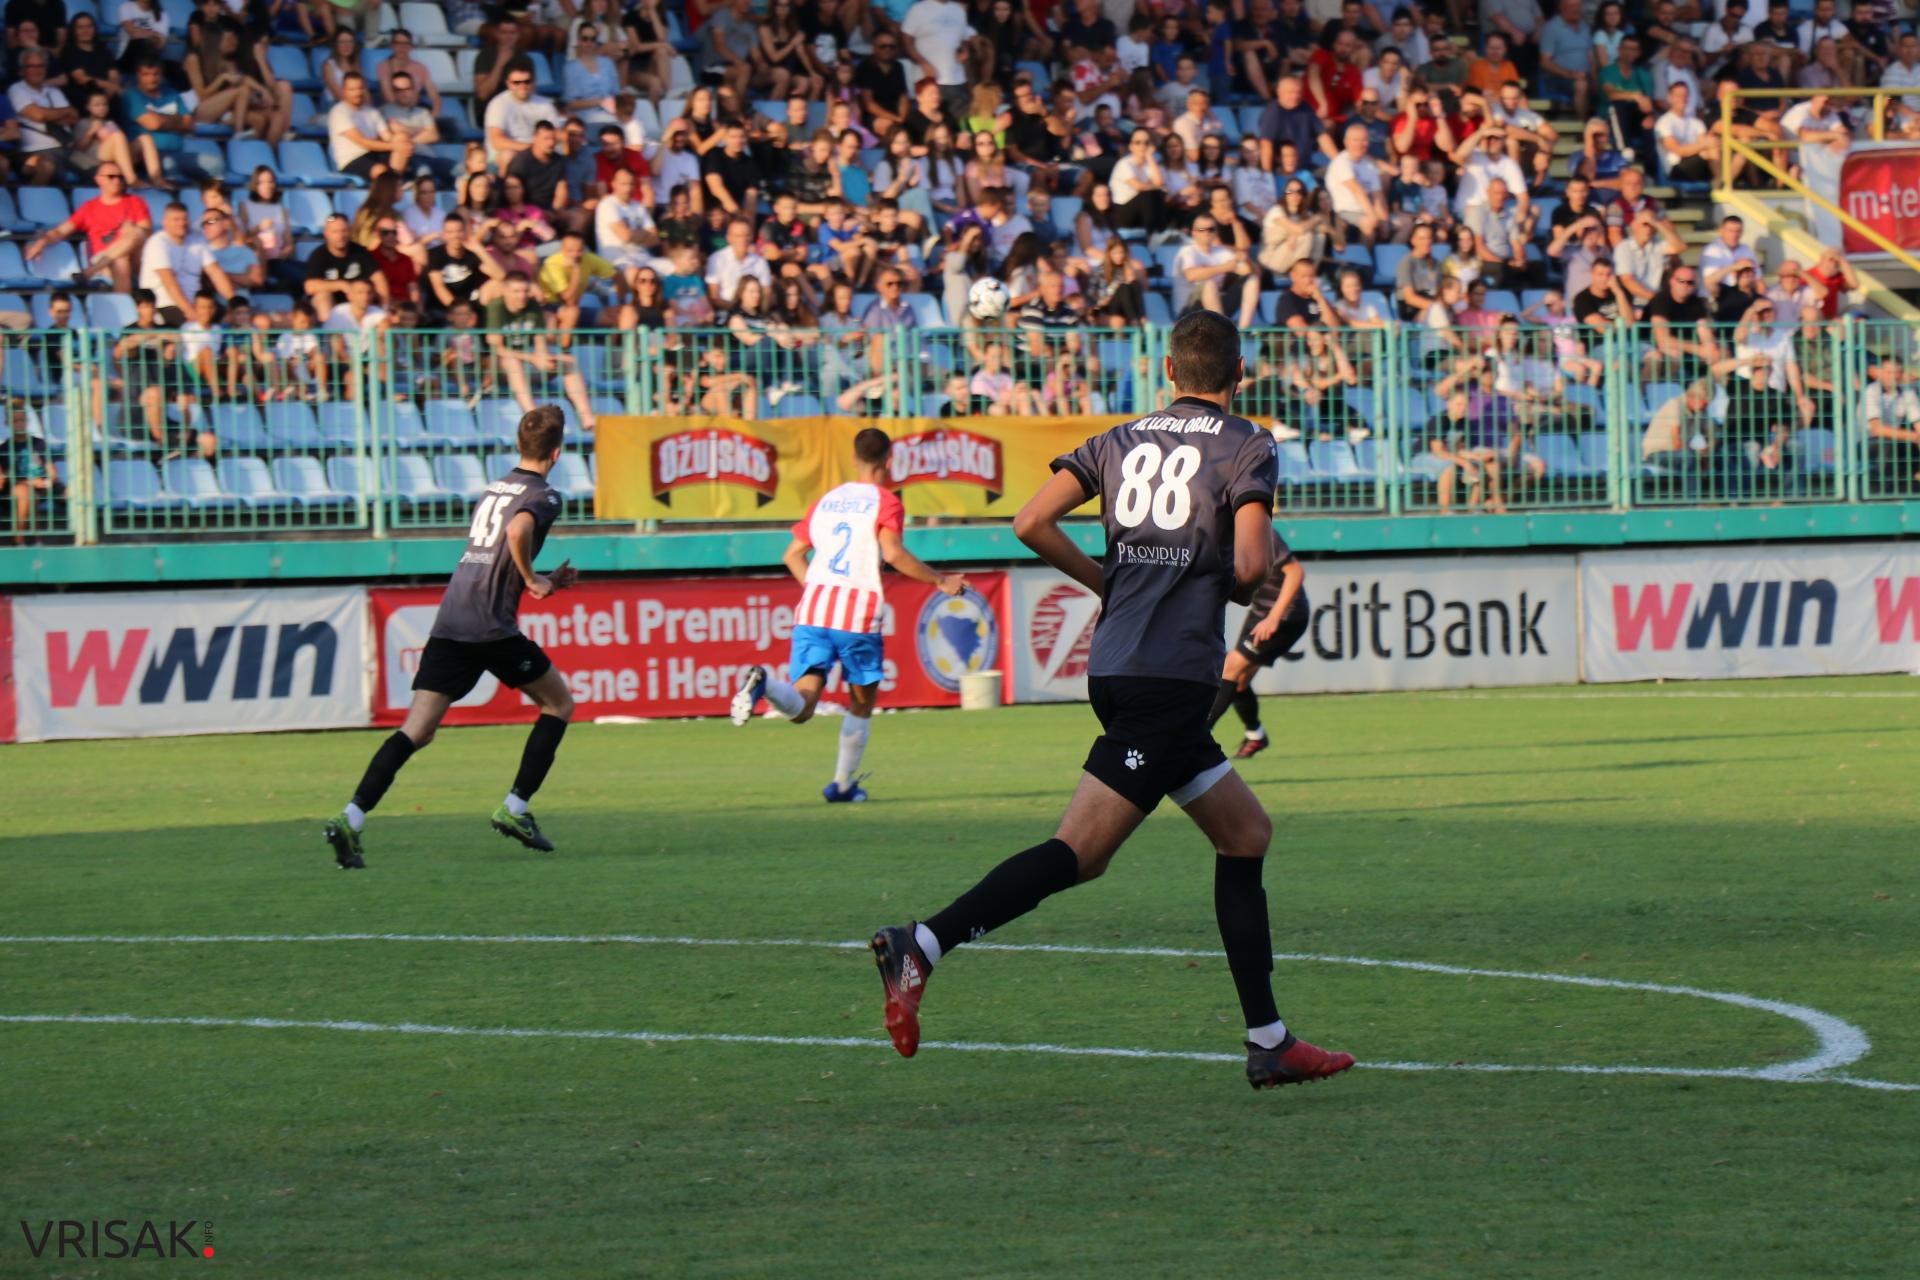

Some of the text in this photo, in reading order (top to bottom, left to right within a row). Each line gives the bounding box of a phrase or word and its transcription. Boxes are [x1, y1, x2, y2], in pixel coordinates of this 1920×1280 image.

[1849, 182, 1920, 220] m:te
[1183, 415, 1224, 436] OBALA
[1115, 442, 1201, 530] 88
[470, 496, 513, 548] 45
[828, 522, 853, 577] 2
[1128, 557, 1159, 565] RESTAURANT
[518, 597, 795, 650] m:tel Premije
[646, 657, 659, 701] i
